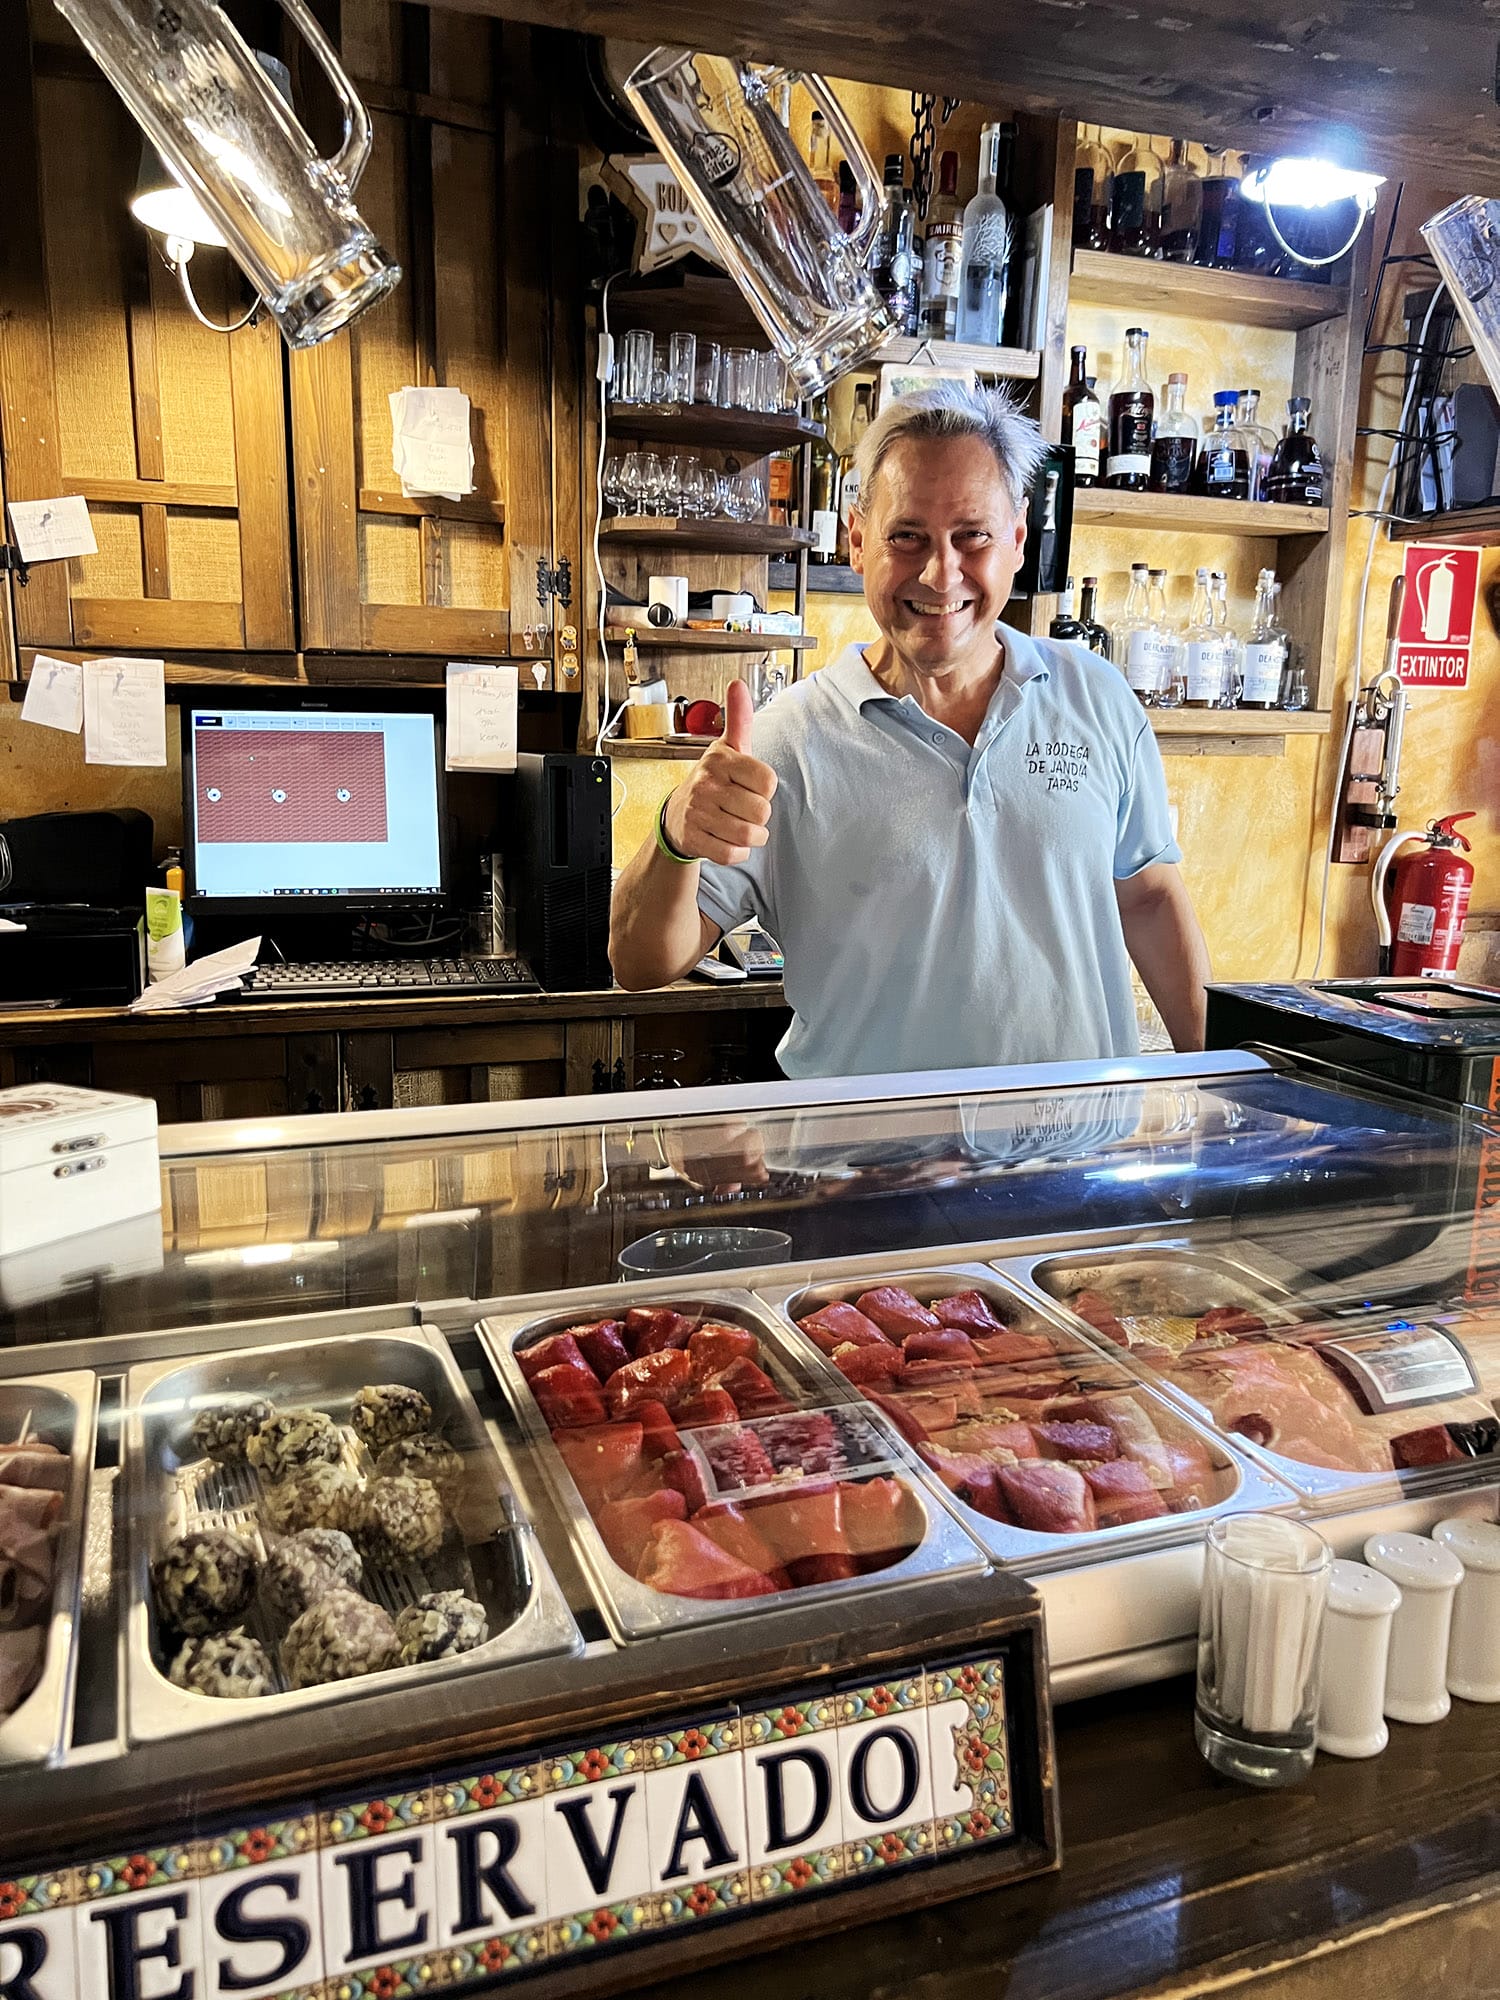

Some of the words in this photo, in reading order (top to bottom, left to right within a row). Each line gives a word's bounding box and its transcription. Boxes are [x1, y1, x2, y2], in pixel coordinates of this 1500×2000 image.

[656, 182, 697, 215] BOD
[1400, 655, 1465, 678] EXTINTOR
[1026, 742, 1040, 756] LA
[1045, 742, 1089, 760] BODEGA
[1028, 760, 1046, 774] DE
[1050, 760, 1088, 778] JANDIA
[1047, 777, 1079, 792] TAPAS
